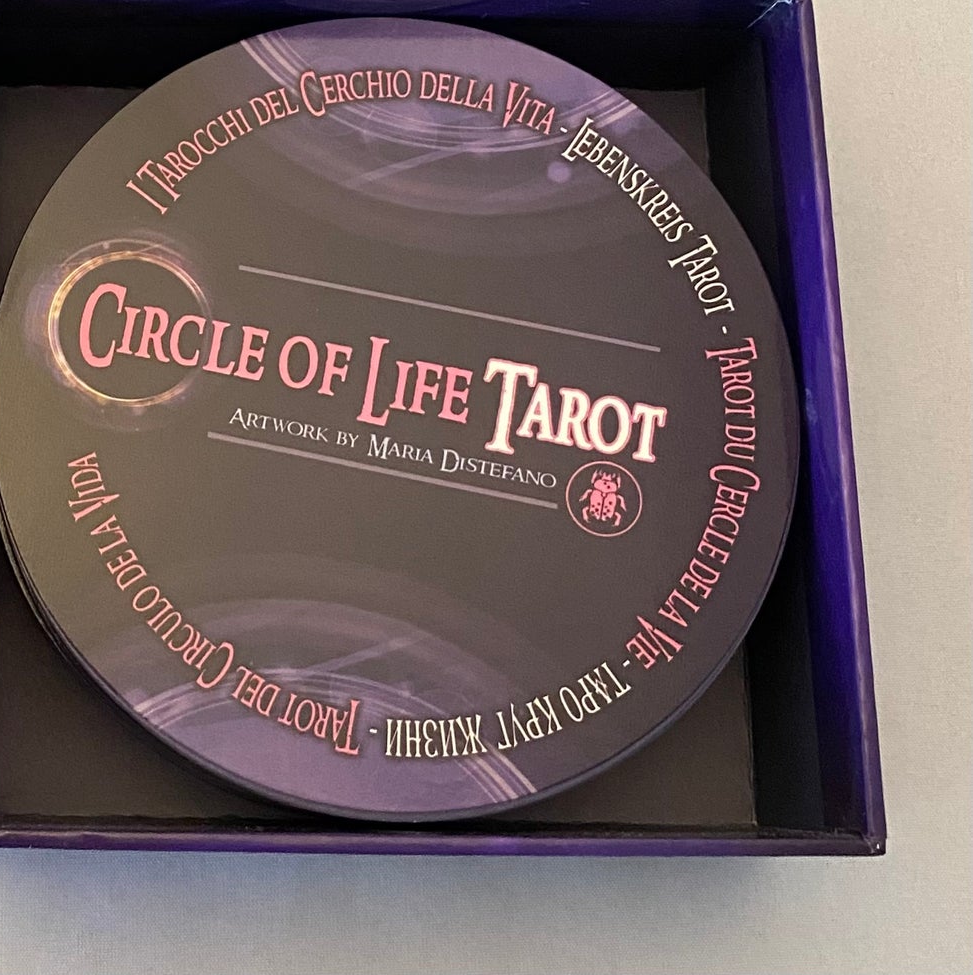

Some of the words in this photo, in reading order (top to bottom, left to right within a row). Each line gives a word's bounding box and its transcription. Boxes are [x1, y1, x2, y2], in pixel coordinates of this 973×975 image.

[249, 87, 299, 126] DEL
[299, 69, 412, 117] CERCHIO
[419, 71, 494, 112] DELLA
[502, 80, 556, 135] VITA
[136, 108, 253, 202] TAROCCHI
[126, 180, 168, 215] I
[561, 117, 694, 243] LEBENSKREIS
[667, 234, 735, 316] TAROT
[79, 282, 270, 381] CIRCLE
[278, 335, 353, 397] OF
[356, 336, 475, 427] LIFE
[482, 357, 667, 464] TAROT
[704, 337, 758, 419] TAROT
[228, 407, 329, 443] ARTWORK
[336, 432, 358, 449] BY
[367, 433, 434, 465] MARIA
[439, 448, 557, 489] DISTEFANO
[724, 423, 756, 462] DU
[67, 451, 120, 522] VIDA
[698, 464, 761, 564] CERCLE
[90, 514, 128, 555] LA
[106, 548, 147, 591] DE
[680, 557, 721, 600] DE
[658, 589, 701, 628] LA
[132, 585, 234, 689] CIRCULO
[625, 615, 684, 670] VIE
[231, 665, 281, 717] DEL
[559, 661, 632, 722] ТАРО
[277, 693, 360, 755] TAROT
[385, 714, 487, 758] ЖИЗНИ
[495, 695, 563, 750] КРУГ
